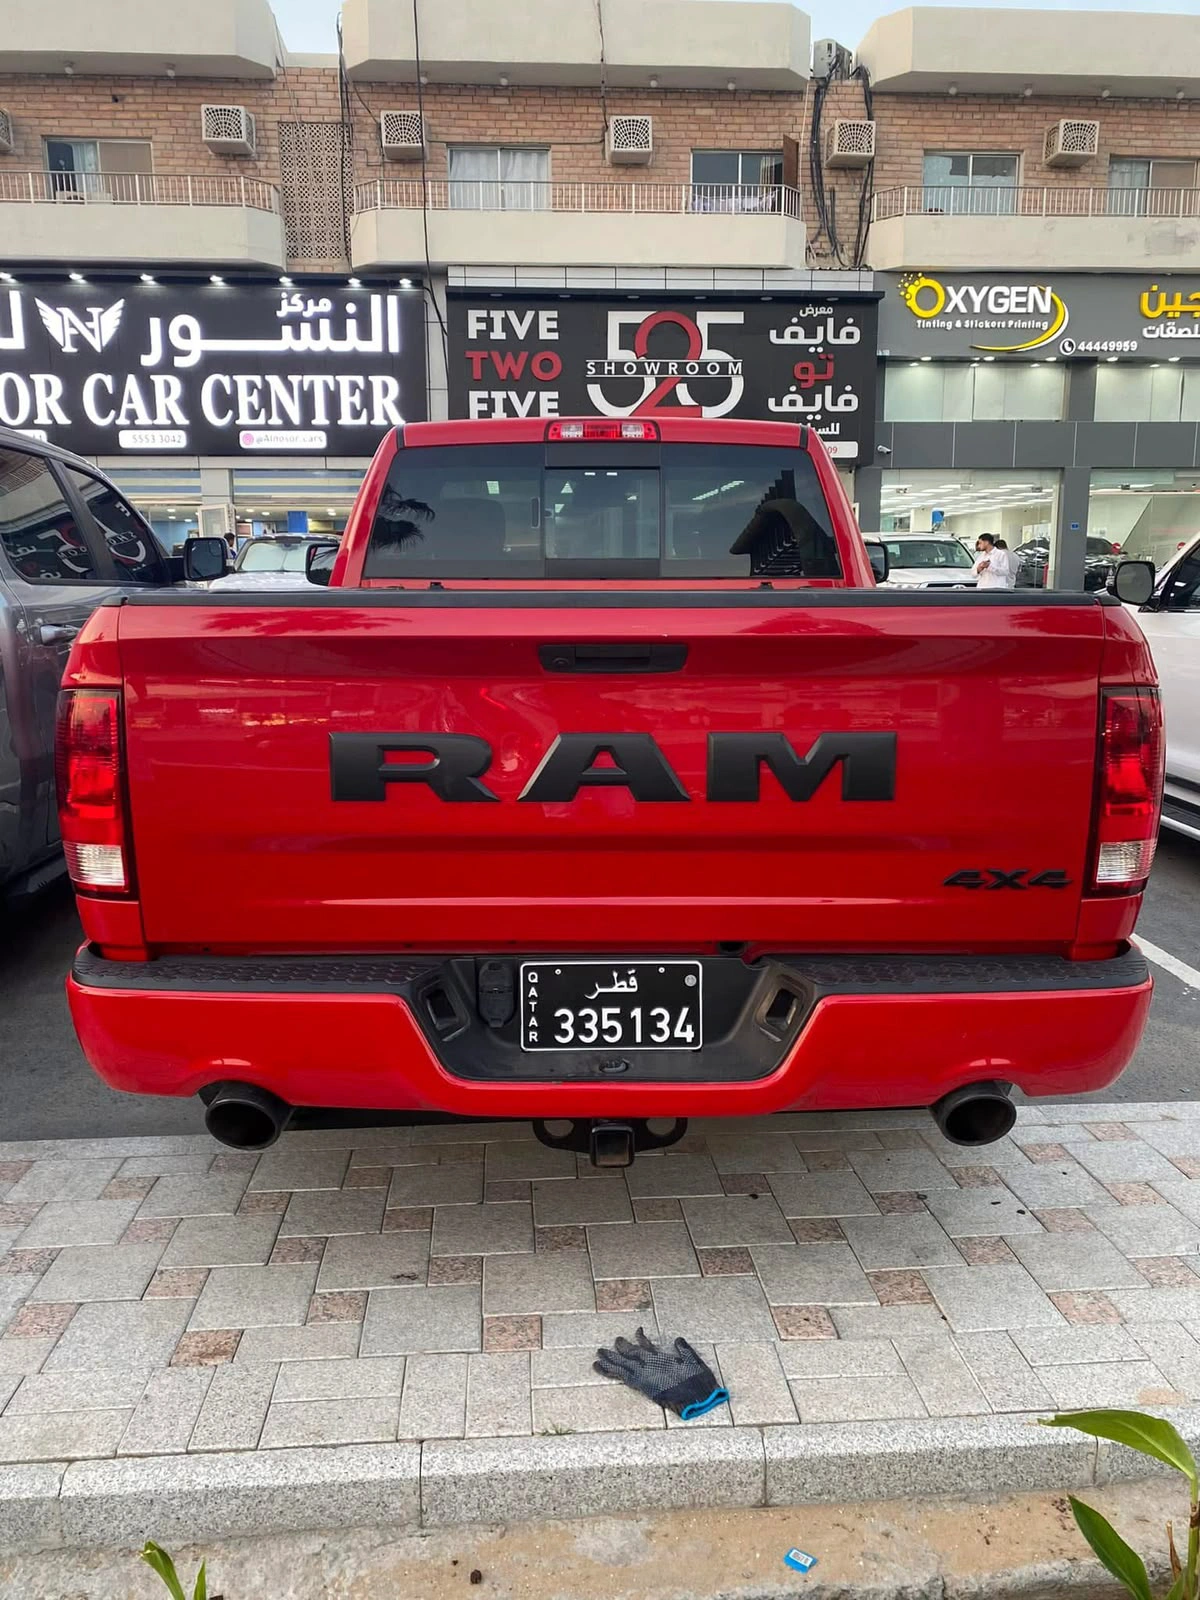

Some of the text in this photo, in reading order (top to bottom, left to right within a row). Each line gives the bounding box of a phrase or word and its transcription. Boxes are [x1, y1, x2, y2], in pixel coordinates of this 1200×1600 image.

[276, 293, 332, 318] مركز
[799, 303, 833, 317] معرض
[903, 274, 1052, 318] OXYGEN
[140, 294, 400, 368] النسور
[467, 309, 559, 340] FIVE
[769, 317, 861, 352] فايف
[916, 319, 953, 330] Tinting
[955, 320, 962, 329] &
[1008, 319, 1049, 330] Printing
[1078, 340, 1138, 351] 44449959
[464, 350, 563, 381] TWO
[586, 310, 745, 418] 525
[586, 361, 743, 376] SHOWROOM
[793, 353, 834, 388] تو
[82, 372, 190, 426] CAR
[200, 372, 406, 427] CENTER
[468, 390, 560, 419] FIVE
[767, 385, 858, 420] فايف
[132, 434, 156, 444] 5553
[328, 731, 897, 802] RAM
[943, 868, 1073, 890] 4X4
[584, 969, 638, 1000] قطر
[527, 971, 539, 1043] QATAR
[554, 1006, 695, 1044] 335134
